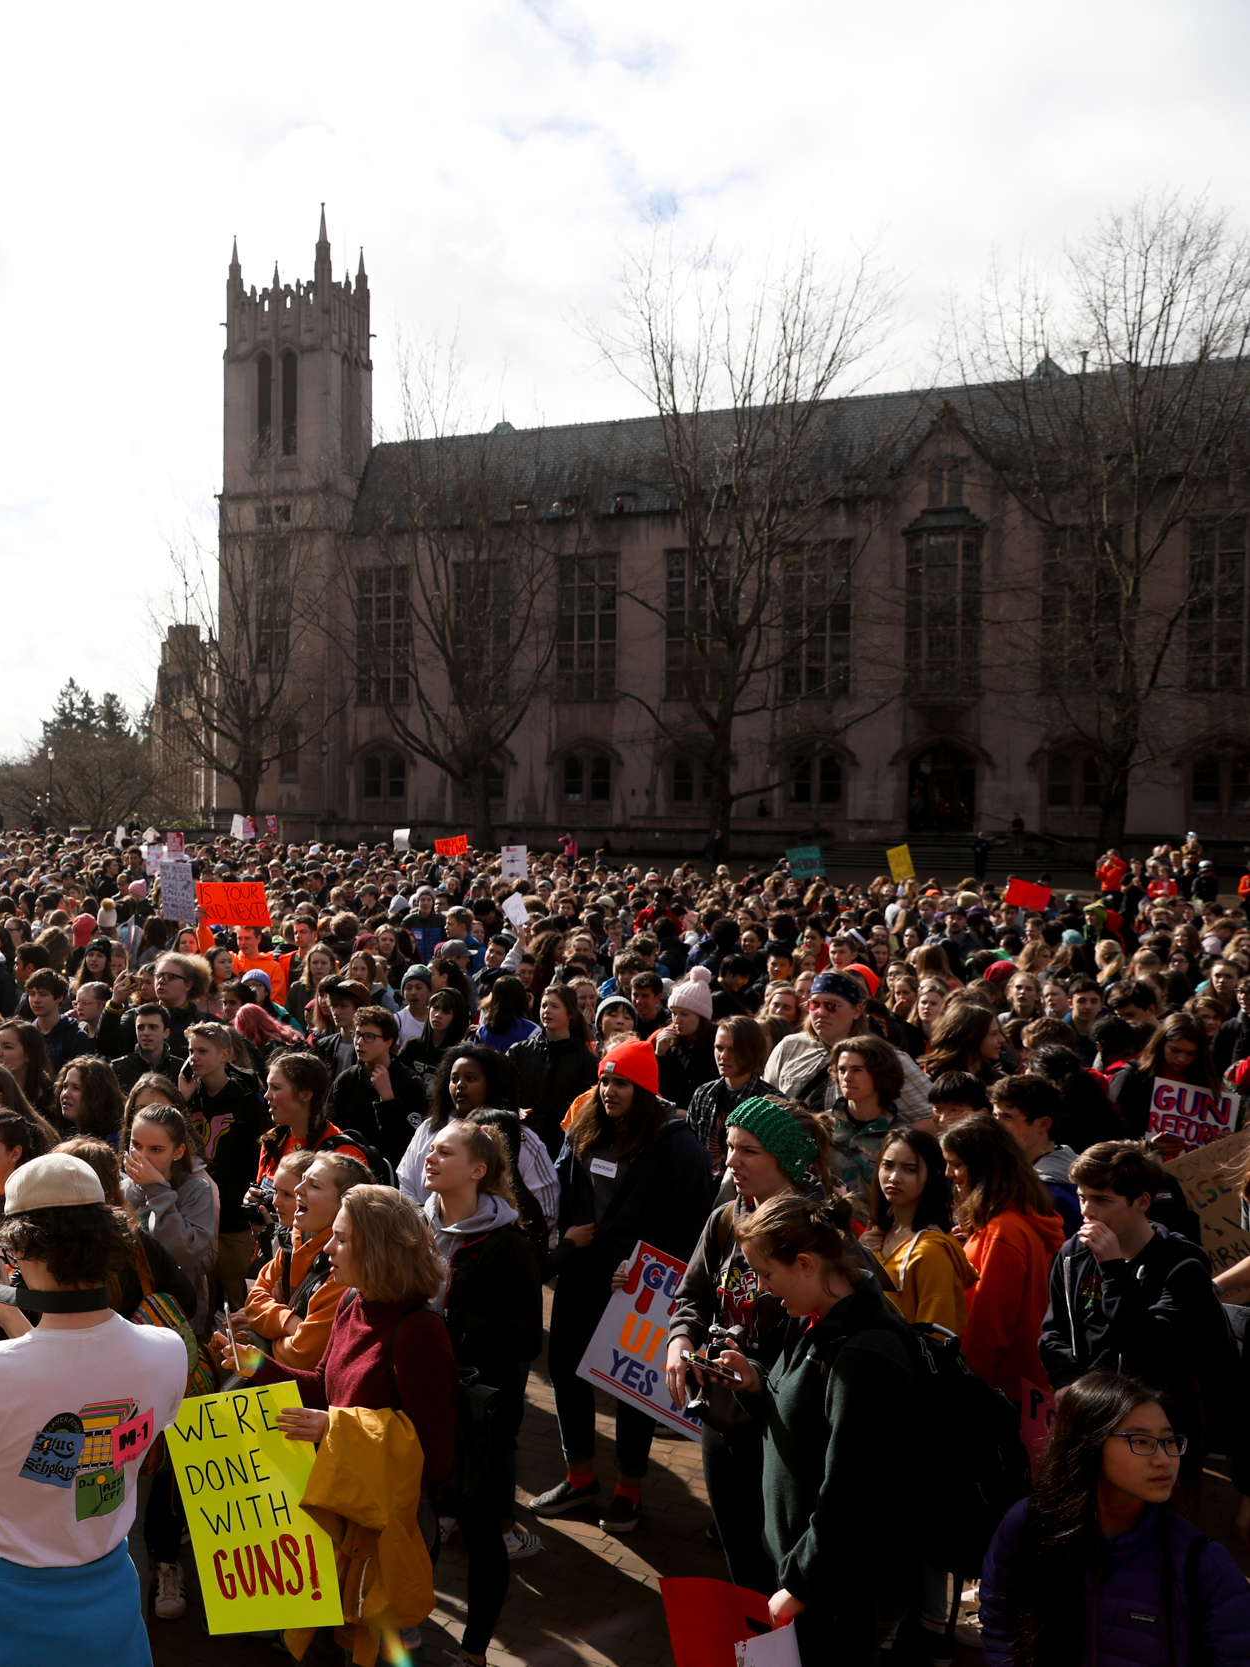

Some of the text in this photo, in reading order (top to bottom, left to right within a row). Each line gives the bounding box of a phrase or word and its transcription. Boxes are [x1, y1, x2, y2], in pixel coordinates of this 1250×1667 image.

[161, 871, 190, 882] PLEASE
[199, 884, 259, 905] IS YOUR
[204, 902, 269, 920] KID NEXT?
[1153, 1084, 1232, 1126] GUN
[592, 1163, 614, 1173] #ENOUGH
[609, 1348, 659, 1397] YES
[173, 1389, 279, 1443] WE'RE
[119, 1421, 149, 1452] M-1
[78, 1478, 96, 1489] DJ
[184, 1448, 271, 1496] DONE
[199, 1490, 292, 1536] WITH
[212, 1533, 323, 1602] GUNS!
